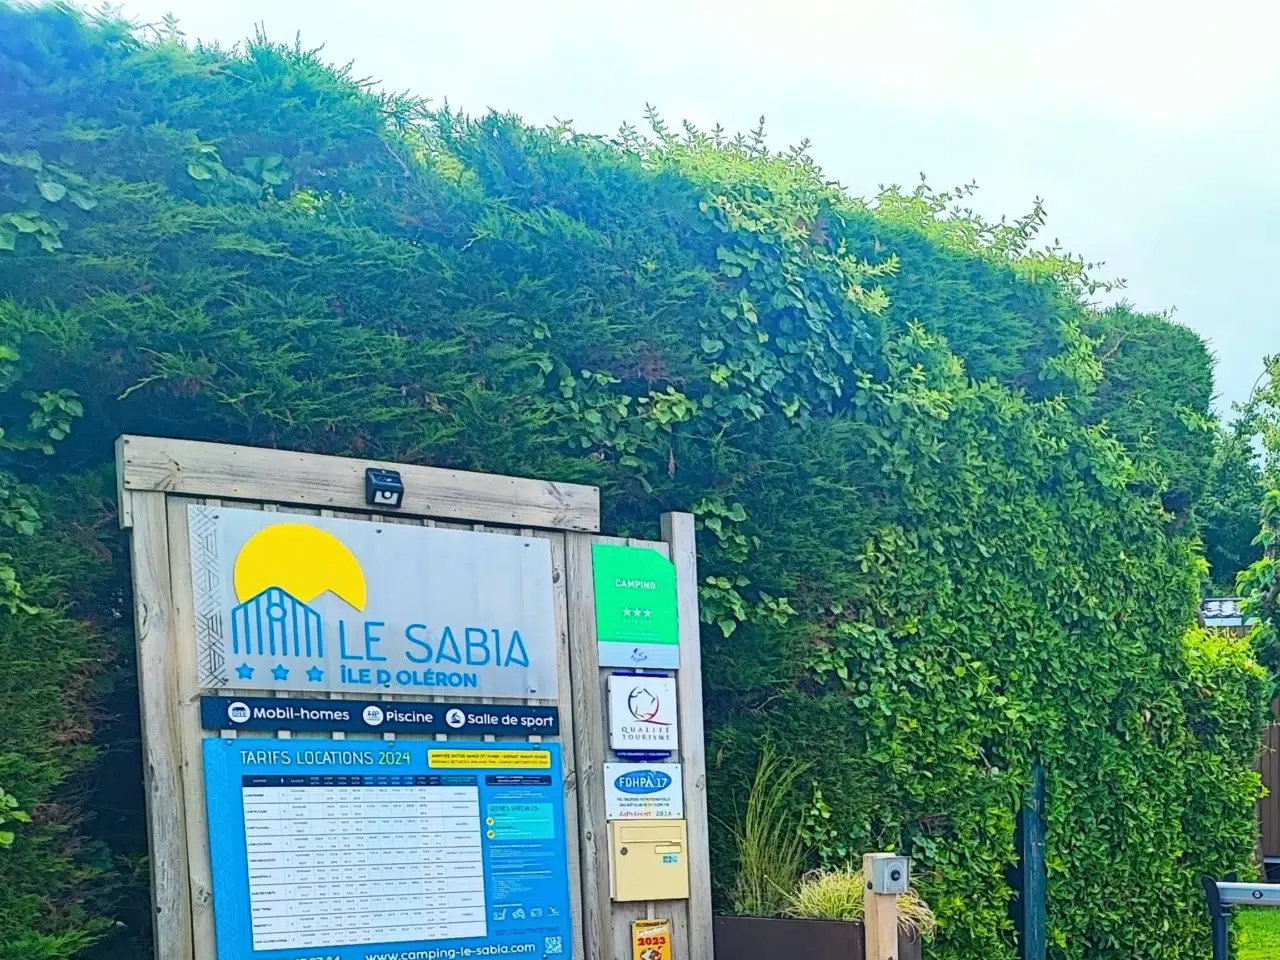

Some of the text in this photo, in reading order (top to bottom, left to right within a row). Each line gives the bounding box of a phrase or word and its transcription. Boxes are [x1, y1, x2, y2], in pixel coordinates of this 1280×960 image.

[615, 579, 656, 589] CAMPING
[339, 620, 530, 667] LE SABIA
[340, 664, 371, 684] ÎLE
[396, 668, 477, 688] OLÉRON
[254, 706, 553, 728] Mobil-homes Piscine Salle de sport
[240, 750, 410, 765] TARIFS LOCATIONS 2024
[620, 776, 667, 787] FDHPA 17
[638, 937, 666, 946] 2023
